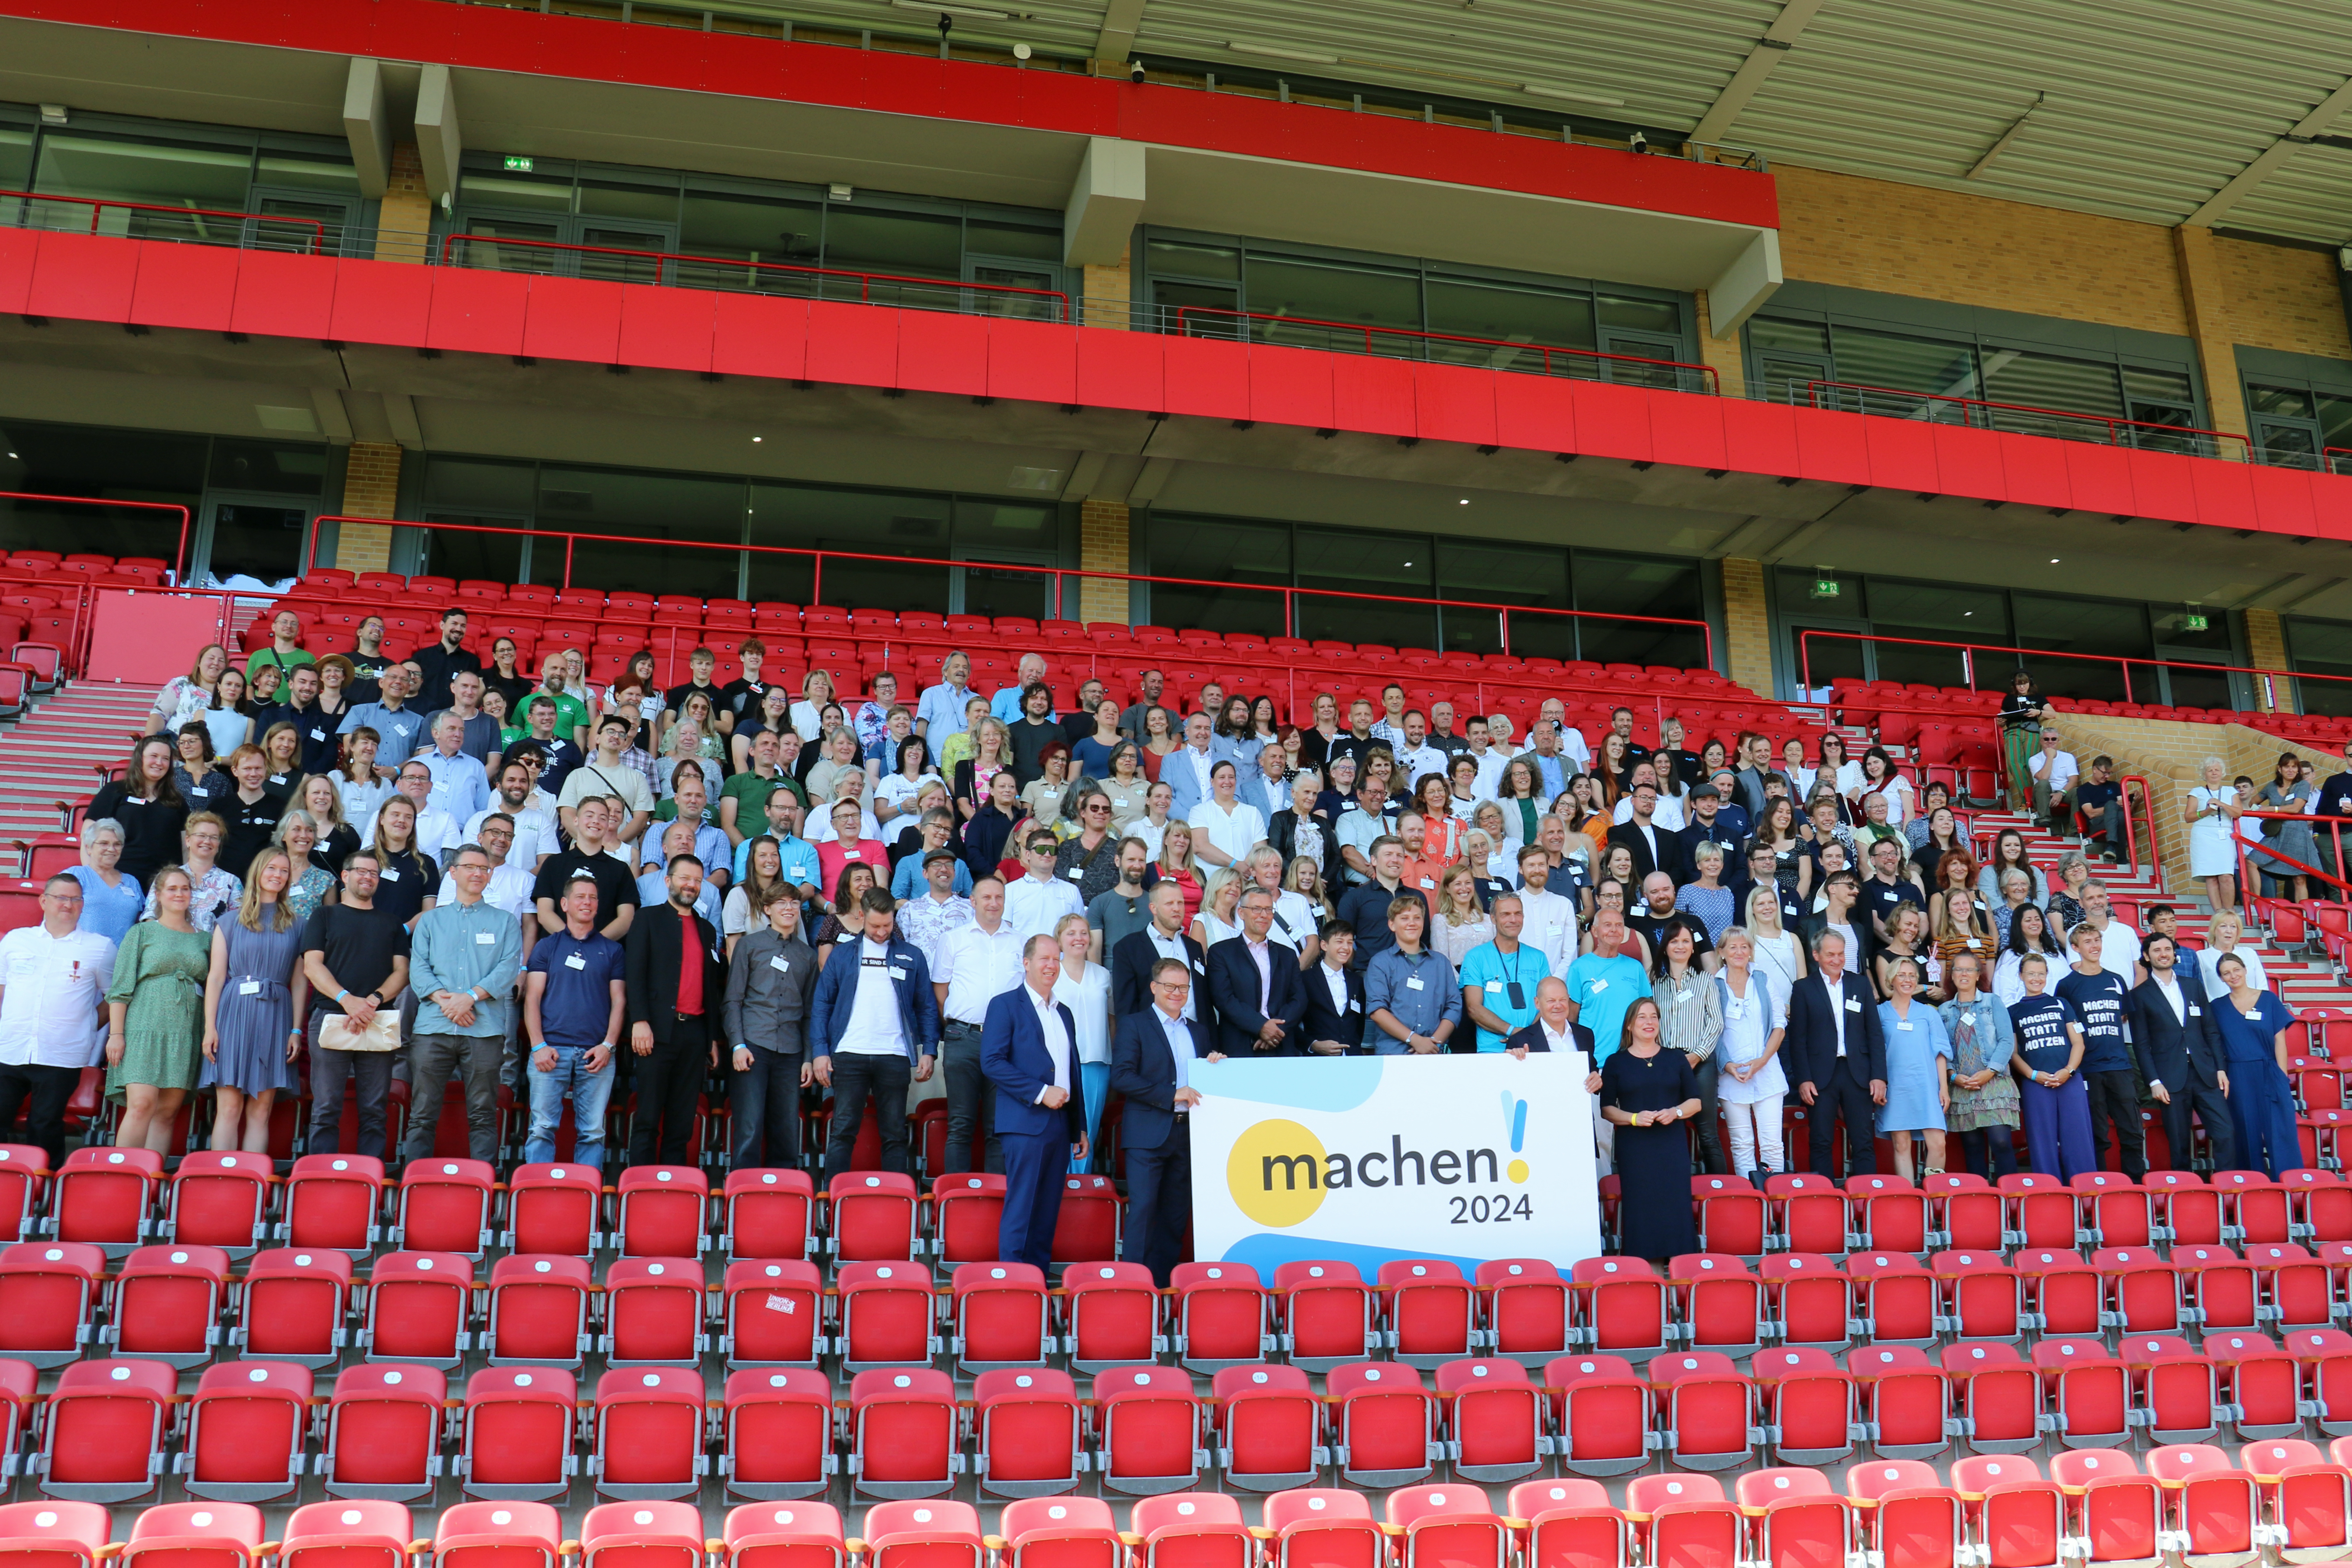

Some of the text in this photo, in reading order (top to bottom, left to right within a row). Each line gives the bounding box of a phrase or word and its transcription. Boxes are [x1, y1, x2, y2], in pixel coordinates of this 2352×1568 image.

[223, 507, 234, 521] 24
[2083, 1000, 2120, 1012] MACHEN
[2018, 1012, 2062, 1027] MACHEN
[2087, 1013, 2115, 1023] STATT
[2024, 1023, 2057, 1038] STATT
[2087, 1025, 2119, 1037] MOTZEN
[2025, 1036, 2065, 1052] MOTZEN
[1449, 1193, 1533, 1224] 2024
[768, 1295, 788, 1304] UNION
[766, 1302, 789, 1311] BERLIN
